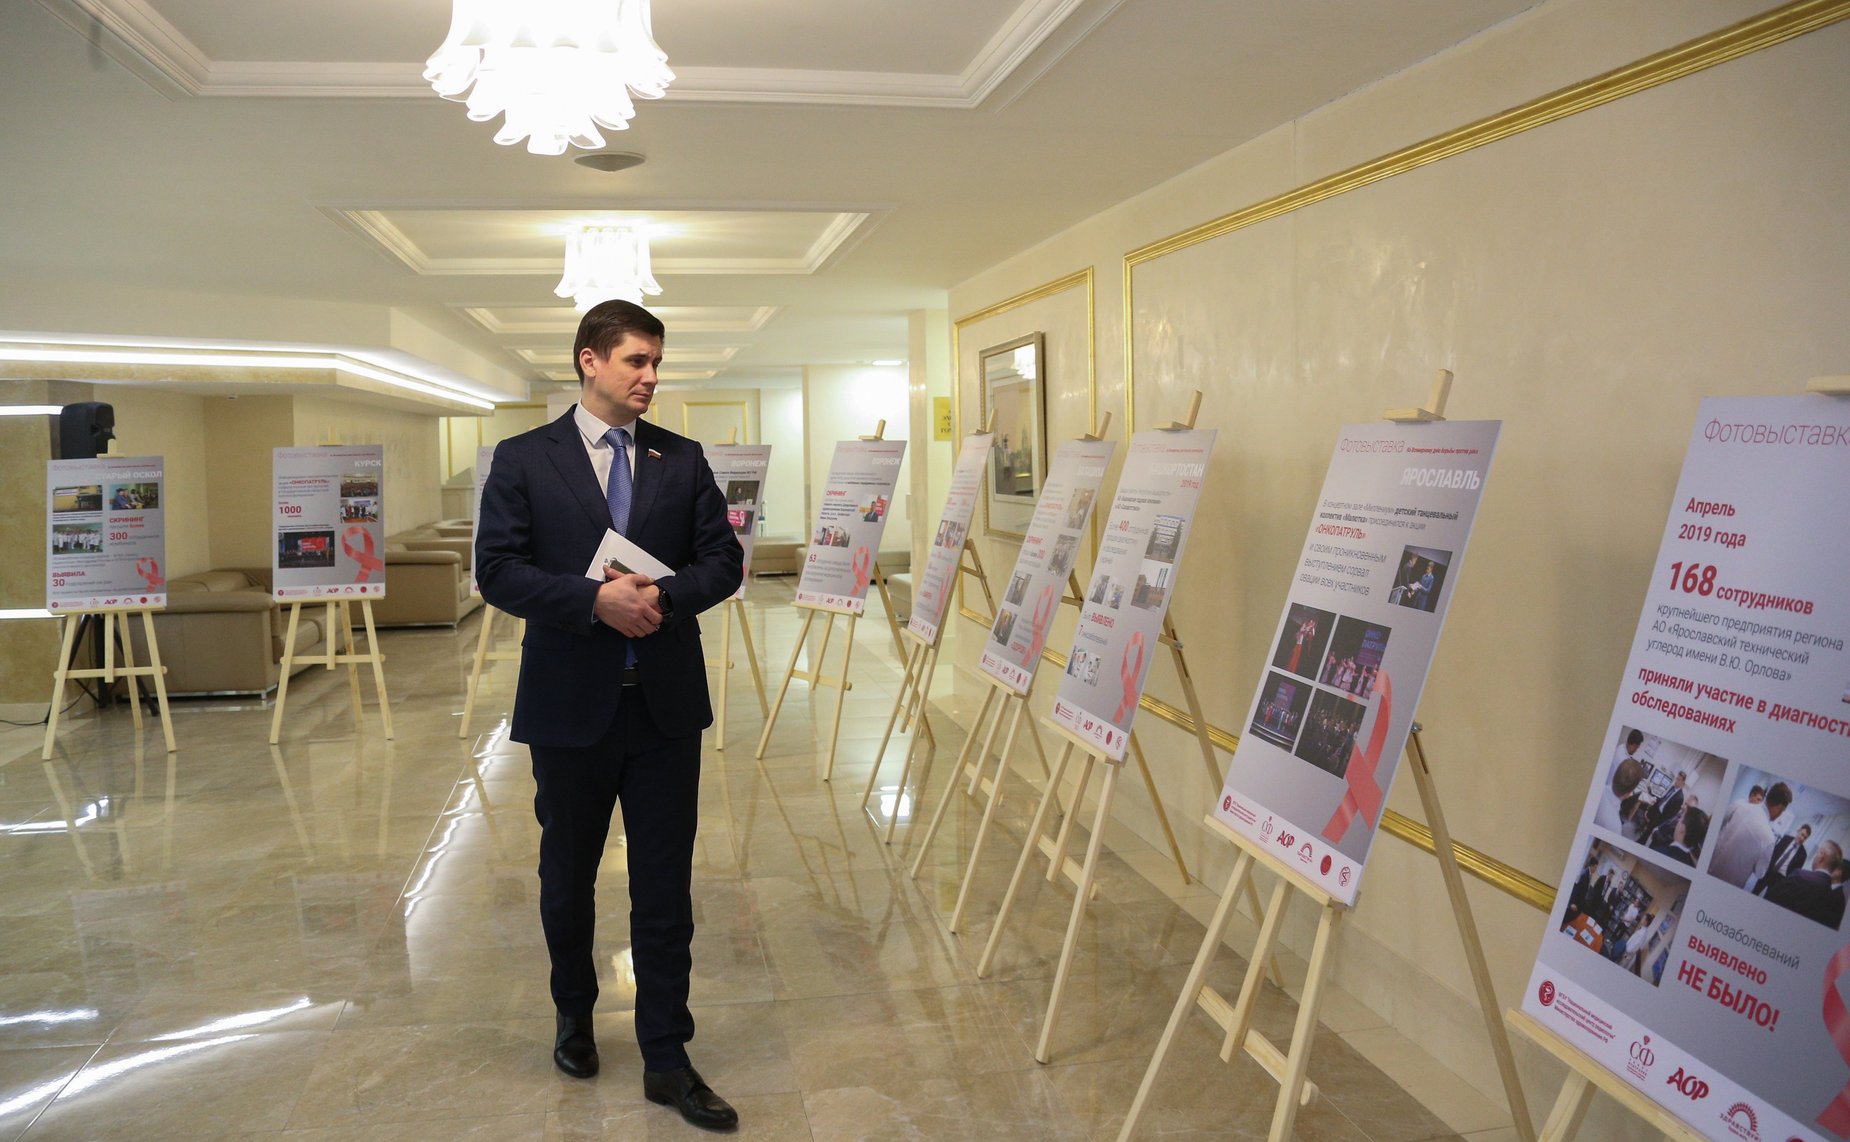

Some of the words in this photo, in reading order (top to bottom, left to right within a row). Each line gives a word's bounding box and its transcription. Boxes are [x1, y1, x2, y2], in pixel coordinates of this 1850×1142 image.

[1705, 418, 1850, 446] Фотовыставк
[1340, 438, 1405, 453] Фотовыставка
[133, 470, 162, 478] ОСКОЛ
[1401, 467, 1481, 490] ЯРОСЛАВЛЬ
[279, 505, 302, 514] 1000
[1394, 507, 1417, 517] детский
[1417, 509, 1459, 521] танцевальный
[1685, 496, 1736, 518] Апрель
[110, 532, 128, 540] 300
[1315, 523, 1366, 540] «ОНКОПАТРУЛЬ»
[1678, 524, 1712, 542] 2019
[1713, 529, 1747, 549] года
[1314, 544, 1334, 554] своим
[1334, 545, 1387, 564] проникновенным
[52, 570, 86, 578] ВЫЯВИЛА
[1304, 557, 1347, 574] выступлением
[1346, 565, 1370, 580] сорвал
[52, 578, 65, 587] 30
[1299, 572, 1320, 585] овации
[1320, 575, 1333, 588] всех
[1333, 578, 1370, 597] участников
[1669, 561, 1717, 597] 168
[1716, 586, 1814, 615] сотрудников
[1657, 604, 1720, 626] крупнейшего
[1721, 617, 1793, 641] предприятия
[1794, 631, 1844, 651] региона
[1651, 619, 1667, 633] АО
[1667, 623, 1738, 650] «Ярославский
[1738, 639, 1810, 665] технический
[1645, 638, 1685, 659] углерод
[1685, 646, 1718, 664] имени
[1719, 653, 1741, 671] В.Ю.
[1744, 659, 1792, 682] Орлова»
[1638, 667, 1694, 693] приняли
[1694, 682, 1754, 710] участие
[1757, 699, 1768, 714] в
[1631, 690, 1736, 734] обследованиях
[1276, 830, 1295, 848] АОР
[1695, 909, 1800, 970] Онкозаболеваний
[1687, 935, 1767, 985] выявлено
[1677, 959, 1707, 992] НЕ
[1706, 975, 1780, 1032] БЫЛО!
[1629, 1041, 1655, 1067] СФ
[1666, 1067, 1710, 1100] АОР
